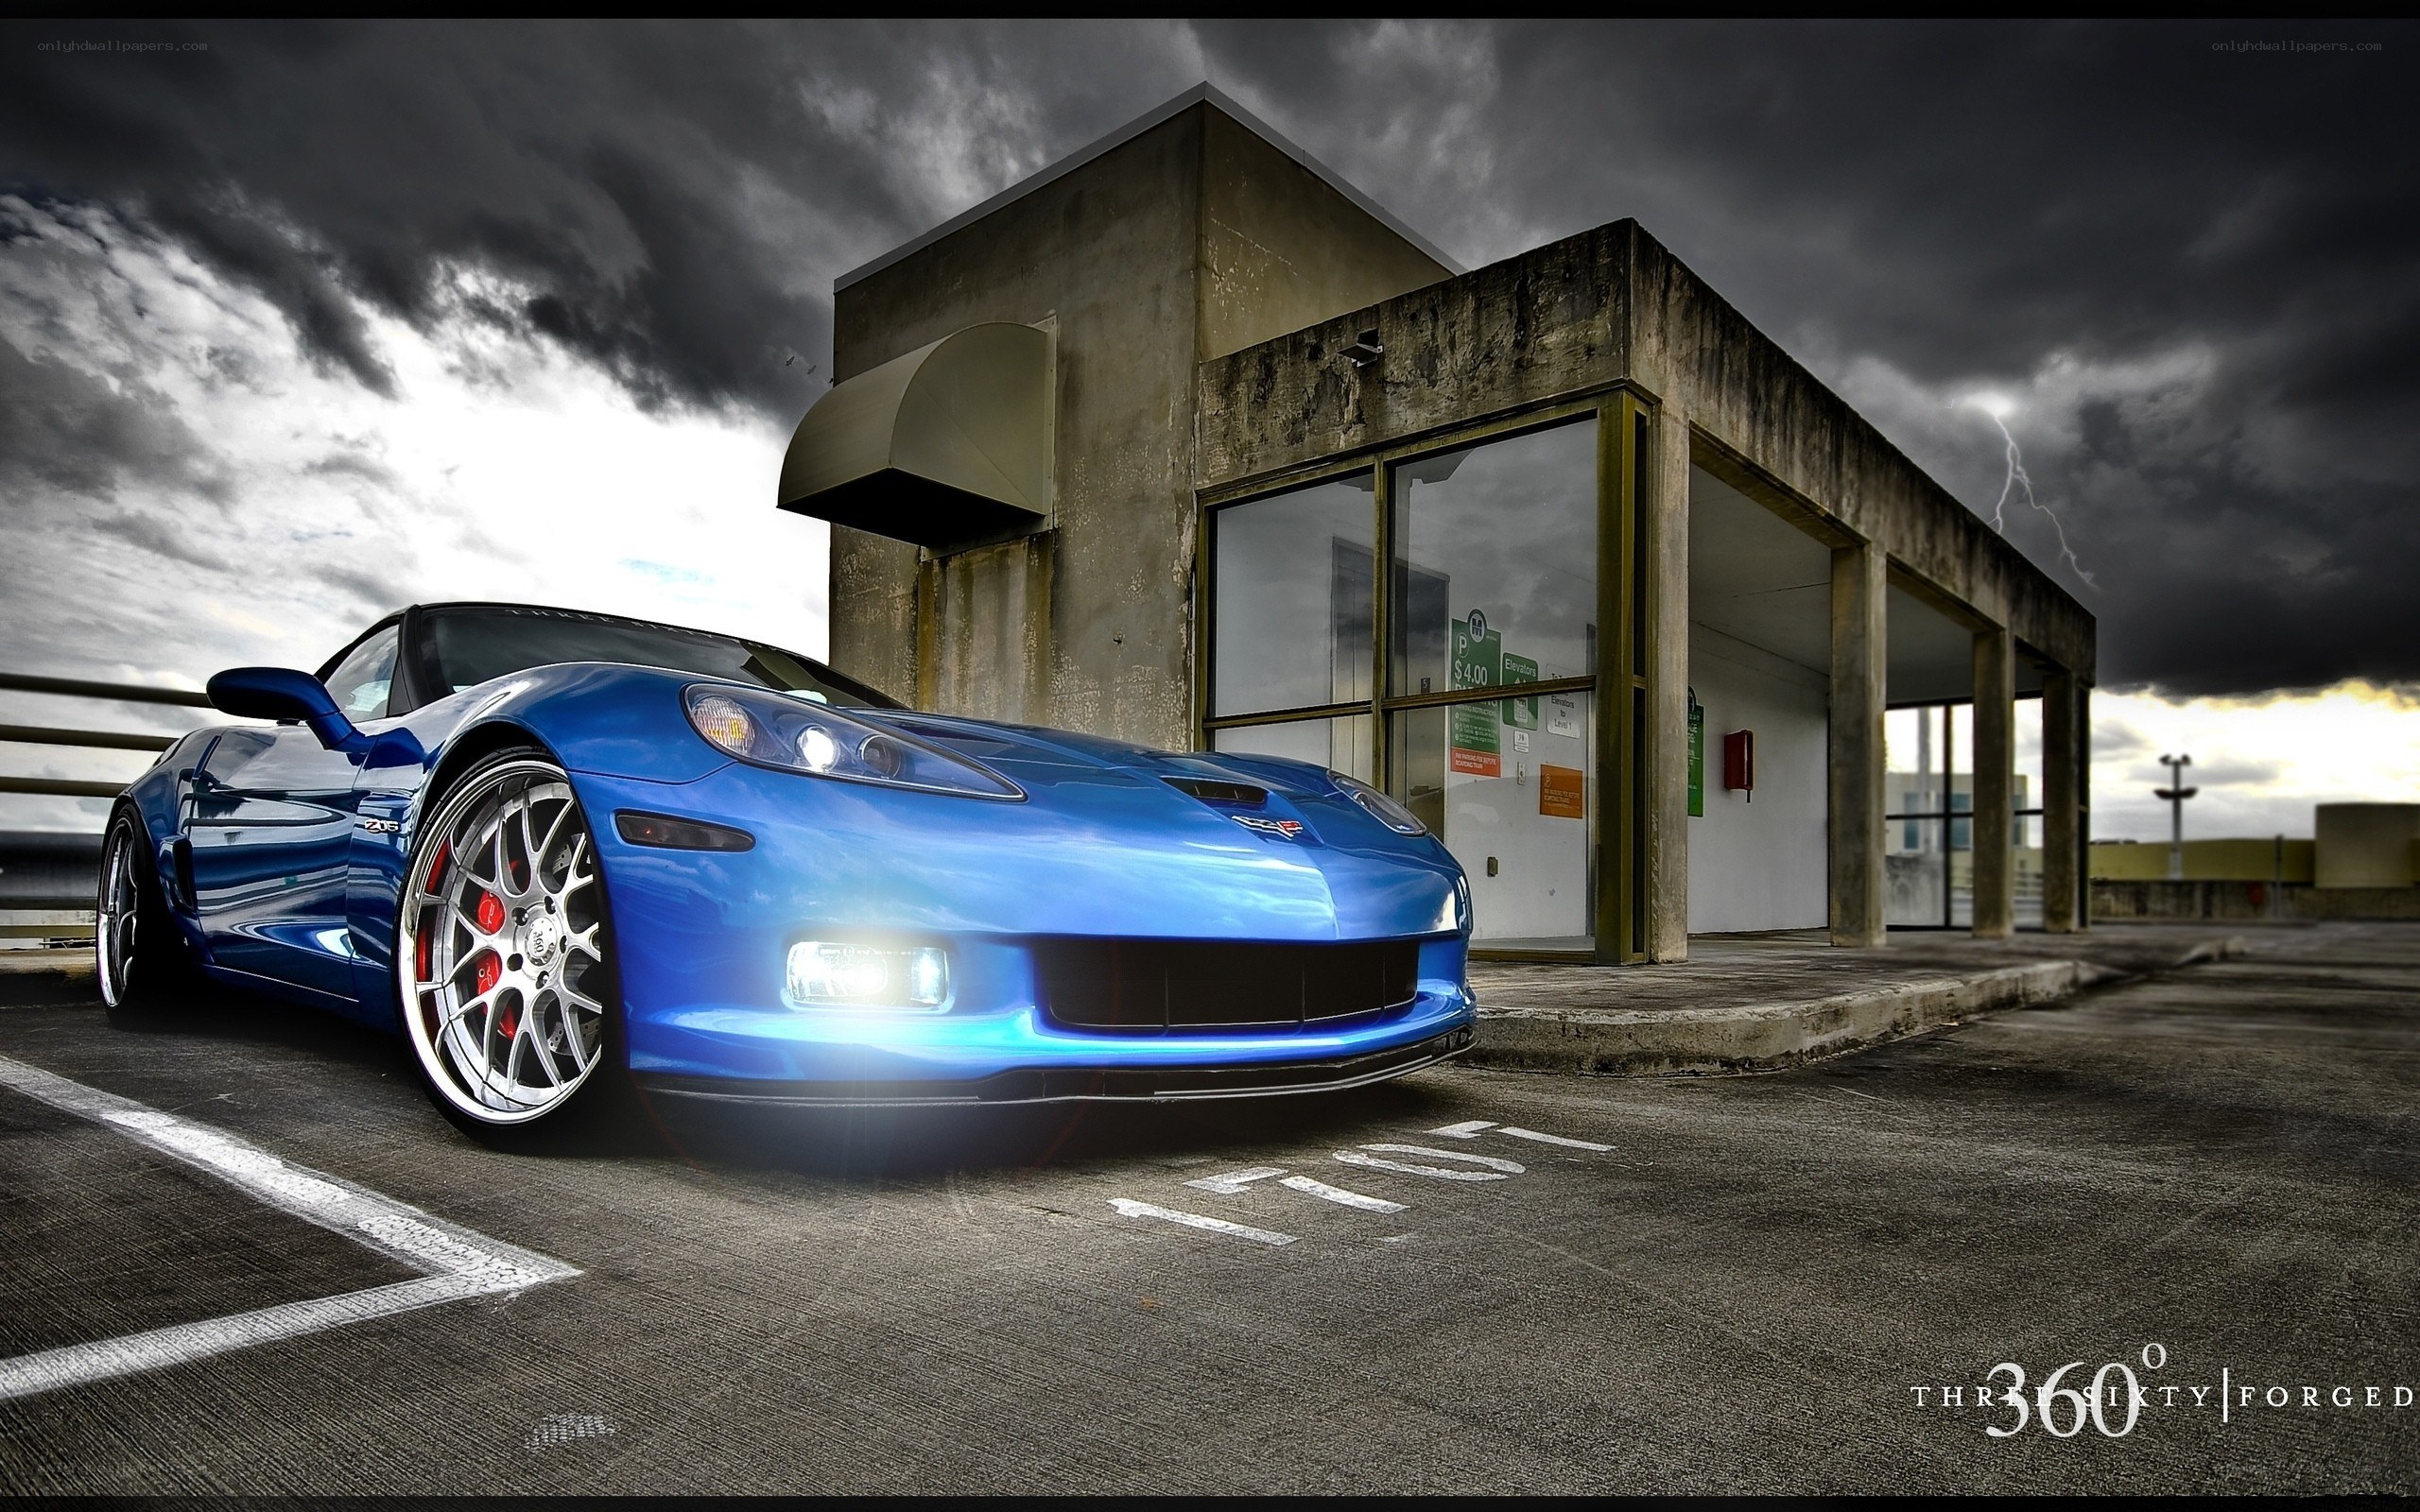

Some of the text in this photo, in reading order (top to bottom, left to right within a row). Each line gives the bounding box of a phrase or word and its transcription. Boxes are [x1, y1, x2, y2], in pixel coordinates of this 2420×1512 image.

[1505, 659, 1537, 678] Elevators
[1550, 696, 1575, 709] Elevators
[1560, 709, 1566, 718] to
[1554, 718, 1568, 730] Level
